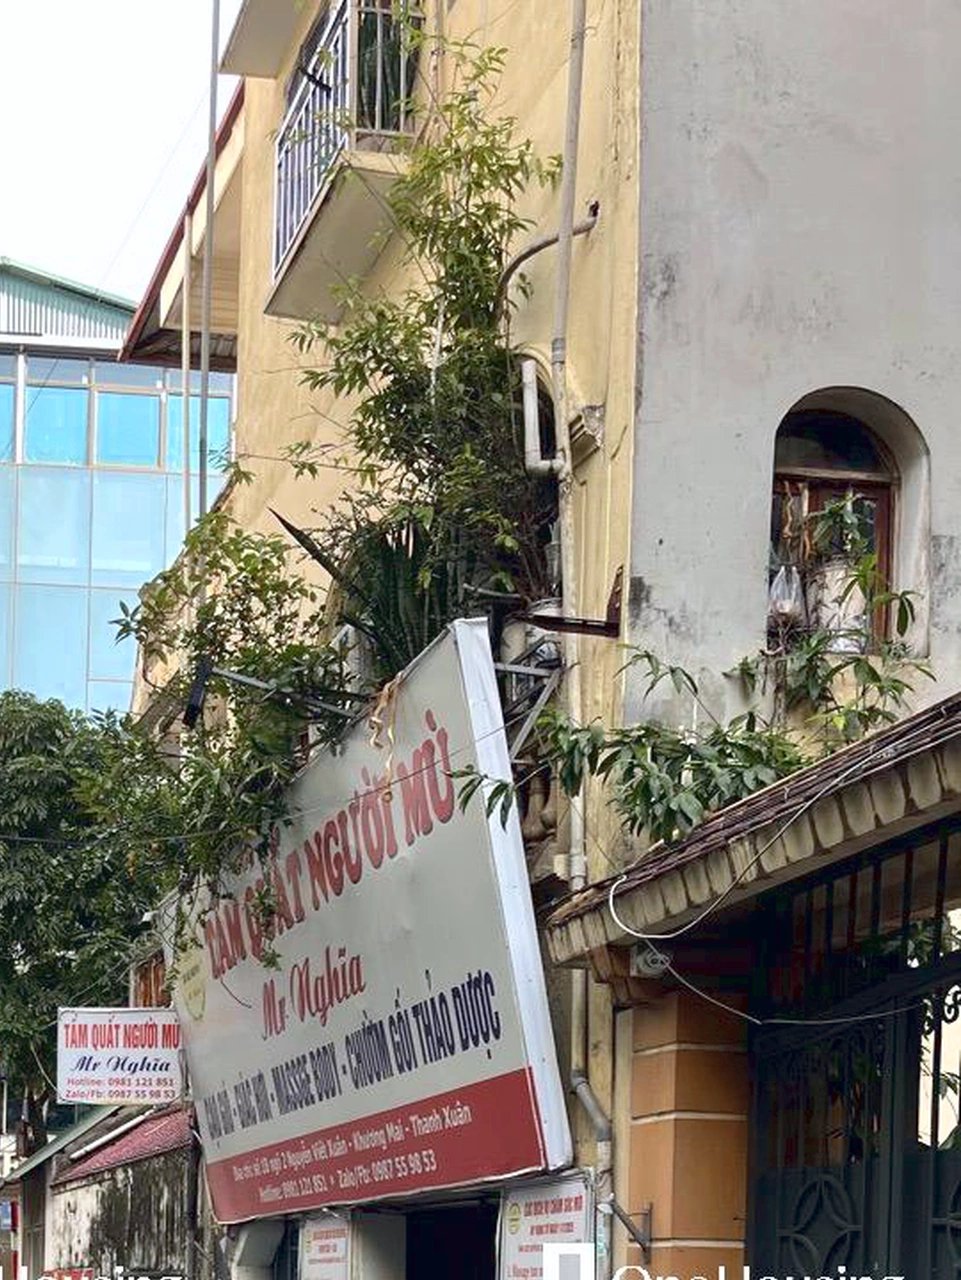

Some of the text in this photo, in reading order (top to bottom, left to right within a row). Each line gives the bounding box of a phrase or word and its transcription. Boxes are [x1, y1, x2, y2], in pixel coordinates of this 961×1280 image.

[305, 766, 398, 911] NGƯỜI
[398, 709, 454, 846] MÙ
[290, 944, 367, 1028] Nghĩa
[123, 1017, 158, 1049] NGƯỜI
[162, 1018, 180, 1049] MÙ
[412, 969, 455, 1065] THẢO
[451, 969, 501, 1060] DƯỢC
[71, 1056, 171, 1075] Mr Nghĩa
[136, 1077, 153, 1087] 121
[409, 1108, 443, 1138] Thanh
[441, 1100, 473, 1130] Xuân
